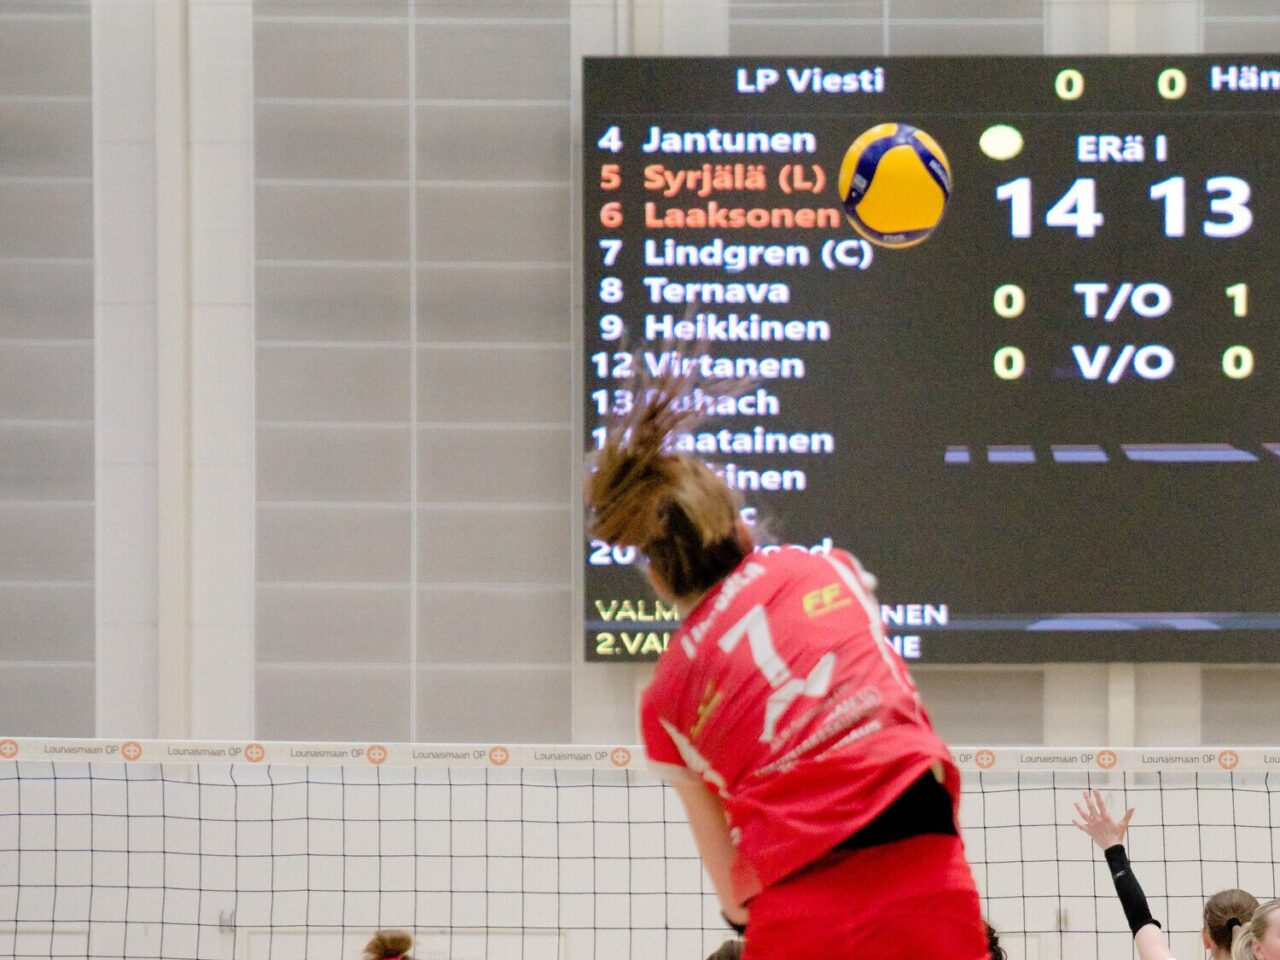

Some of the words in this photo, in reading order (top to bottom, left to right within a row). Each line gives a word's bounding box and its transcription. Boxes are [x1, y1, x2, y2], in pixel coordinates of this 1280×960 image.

[736, 68, 779, 93] LP
[786, 67, 884, 93] Viesti
[1055, 69, 1084, 100] 0
[1157, 69, 1187, 99] 0
[598, 126, 622, 152] 4
[642, 126, 816, 153] Jantunen
[601, 164, 621, 189] 5
[644, 163, 766, 195] Syrjälä
[779, 164, 826, 194] (L)
[600, 202, 623, 228] 6
[645, 201, 840, 228] Laaksonen
[996, 177, 1103, 238] 14
[1150, 176, 1253, 238] 13
[599, 239, 622, 266] 7
[645, 238, 809, 271] Lindgren
[821, 240, 873, 270] (C)
[599, 277, 623, 303] 8
[643, 276, 790, 304] Ternava
[994, 284, 1025, 318] 0
[1073, 283, 1172, 322] T/O
[1226, 283, 1247, 317] 1
[599, 314, 625, 341] 9
[645, 313, 830, 341] Heikkinen
[592, 352, 634, 379] 12
[643, 351, 805, 379] Virtanen
[994, 346, 1025, 379] 0
[1071, 344, 1174, 383] V/O
[1222, 346, 1254, 378] 0
[591, 389, 634, 415] 13
[661, 426, 834, 453] aatainen
[595, 600, 680, 621] VALM
[44, 745, 103, 754] Lounaismaan
[106, 745, 118, 754] OP
[168, 747, 226, 756] Lounaismaan
[229, 747, 241, 756] OP
[290, 749, 349, 758] Lounaismaan
[351, 749, 364, 758] OP
[412, 750, 470, 759] Lounaismaan
[473, 750, 486, 759] OP
[534, 751, 592, 761] Lounaismaan
[595, 751, 607, 761] OP
[1021, 754, 1078, 763] Lounaismaan
[1081, 754, 1094, 763] OP
[1142, 754, 1200, 763] Lounaismaan
[1203, 754, 1215, 763] OP
